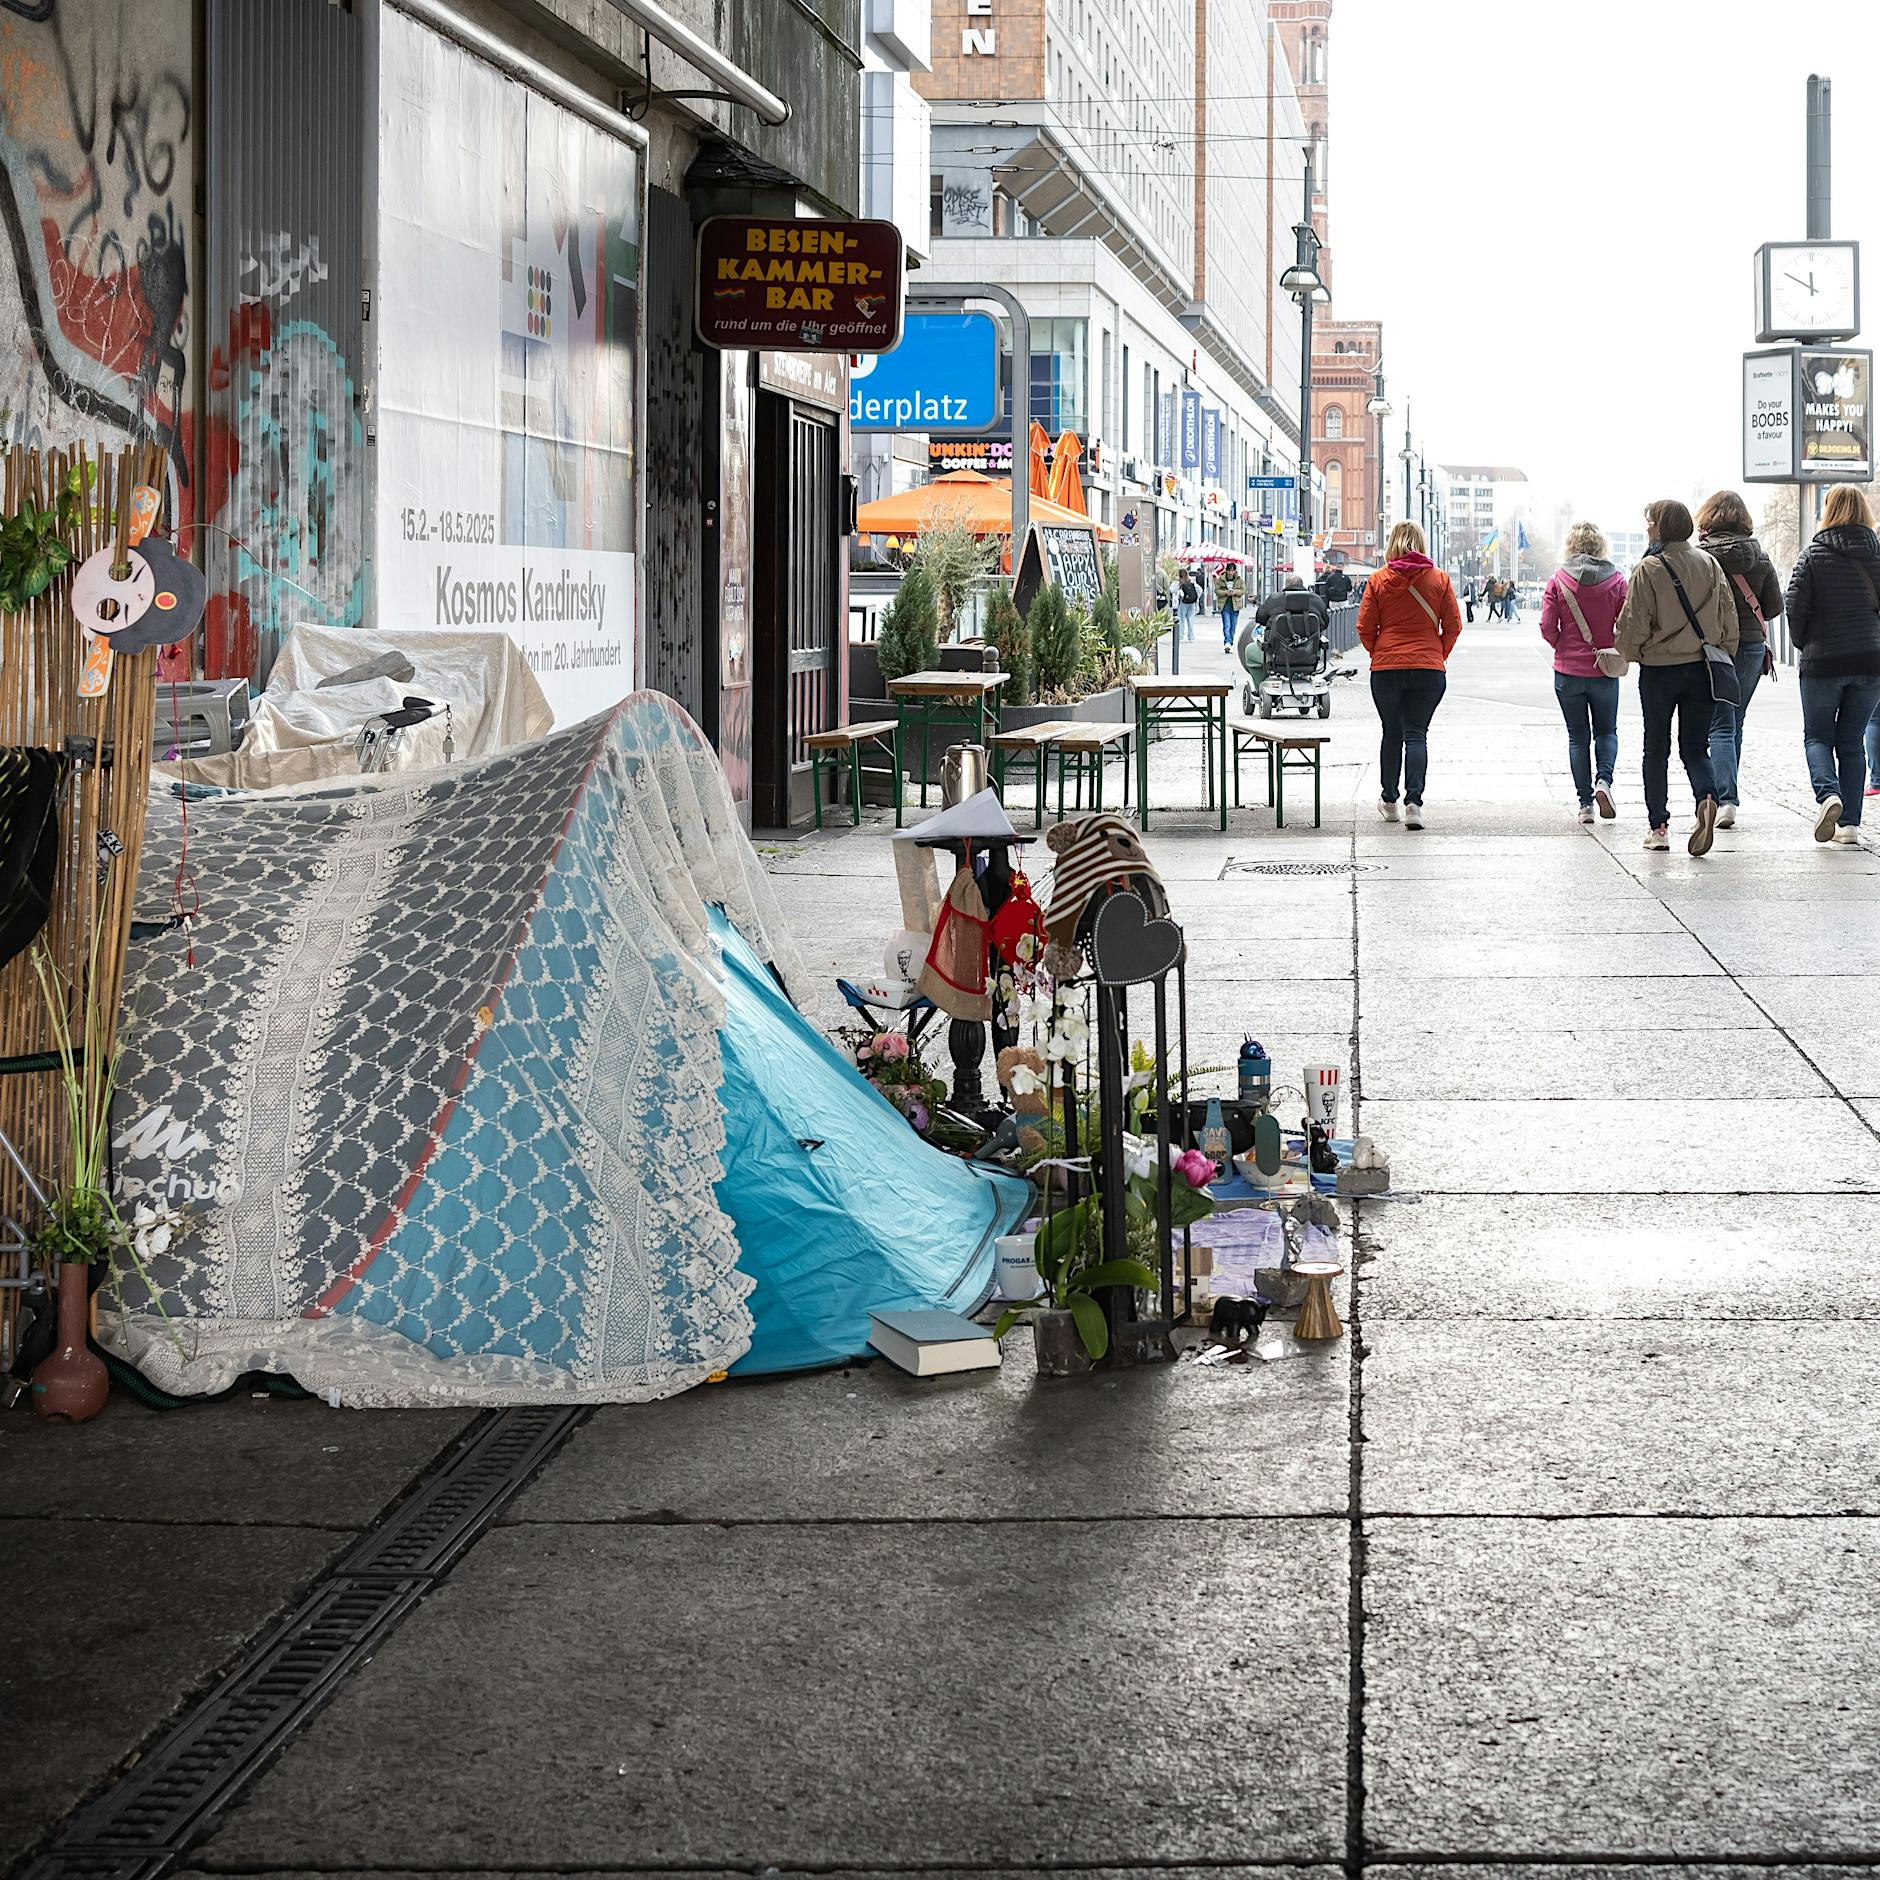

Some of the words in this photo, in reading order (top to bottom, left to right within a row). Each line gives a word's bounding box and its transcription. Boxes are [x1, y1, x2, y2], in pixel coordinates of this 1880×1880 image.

[746, 228, 858, 254] BESEN-
[717, 258, 882, 285] KAMMER-
[766, 286, 835, 311] BAR
[714, 318, 747, 330] rund
[751, 321, 772, 332] um
[776, 319, 797, 332] die
[801, 320, 827, 333] Uhr
[829, 320, 888, 336] geöffnet
[849, 390, 968, 427] derplatz
[1757, 400, 1767, 409] Do
[1768, 400, 1782, 410] your
[1805, 402, 1840, 416] MAKES
[1843, 404, 1864, 417] YOU
[1186, 398, 1195, 449] DECATHLON
[1752, 411, 1789, 428] BOOBS
[1815, 418, 1853, 432] HAPPY!
[1207, 414, 1216, 461] DECATHLON
[1762, 430, 1783, 440] favour
[929, 442, 989, 458] UNKIN'
[941, 458, 988, 470] COFFEE
[1048, 553, 1090, 588] HAPPY
[436, 565, 517, 625] Kosmos
[522, 567, 606, 631] Kandinsky
[541, 642, 552, 672] im
[554, 641, 570, 670] 20.
[570, 639, 621, 670] Jahrhundert
[1320, 1117, 1336, 1126] KFC
[1203, 1127, 1228, 1137] SAVE
